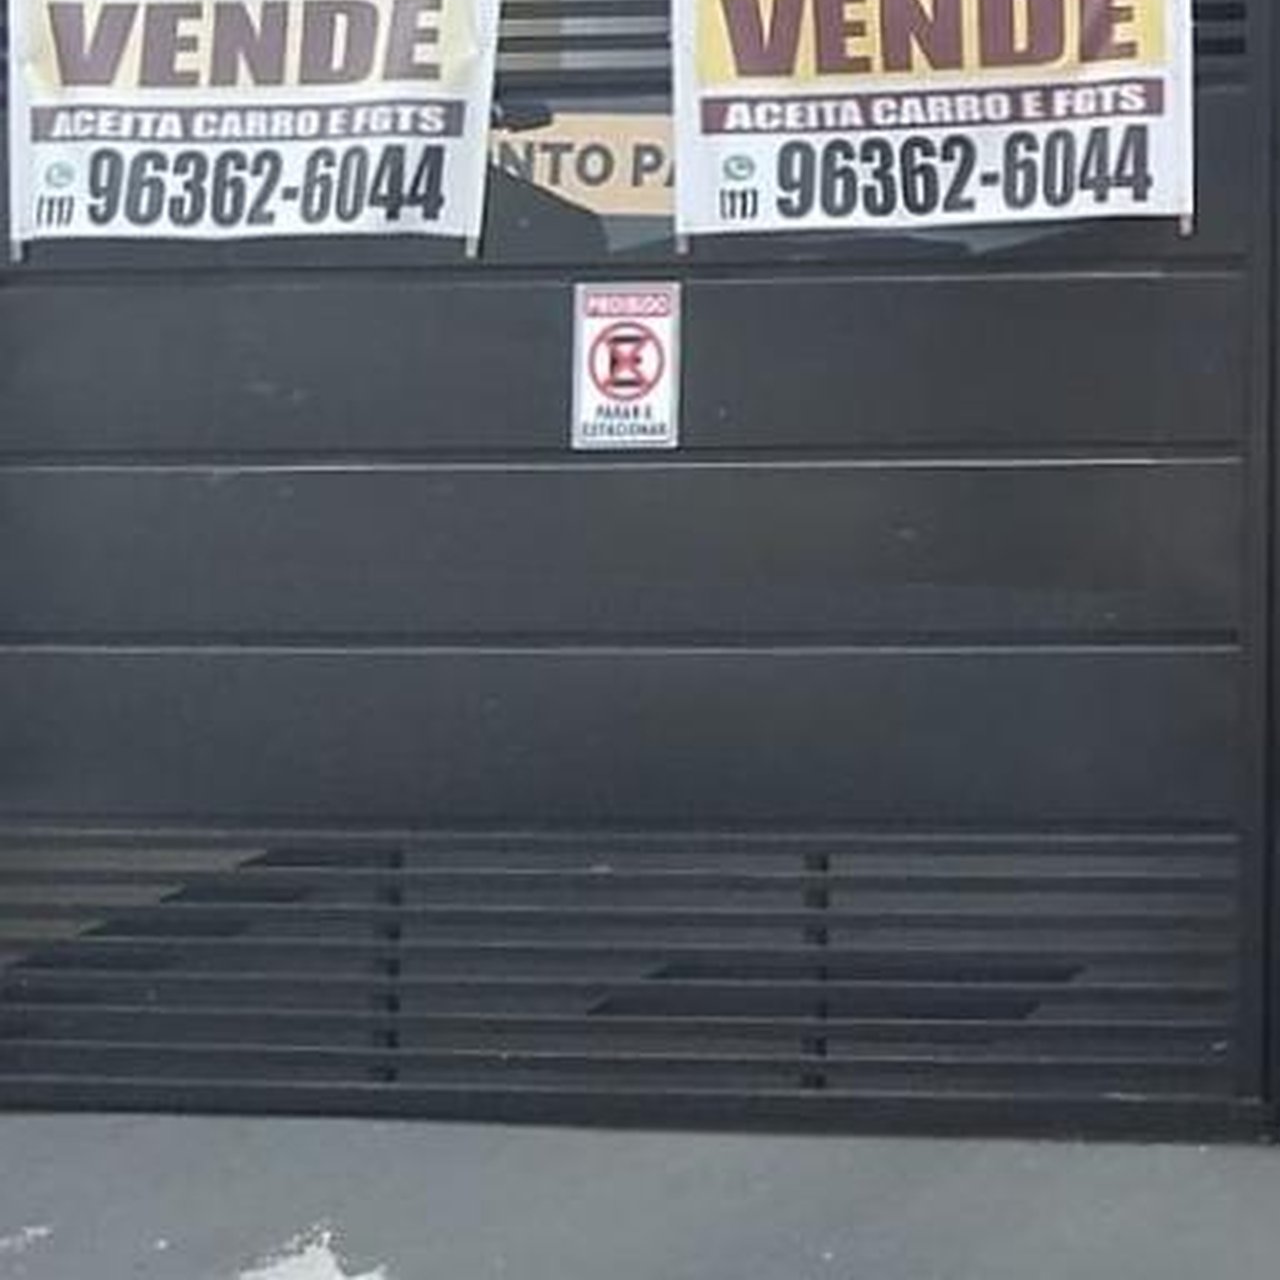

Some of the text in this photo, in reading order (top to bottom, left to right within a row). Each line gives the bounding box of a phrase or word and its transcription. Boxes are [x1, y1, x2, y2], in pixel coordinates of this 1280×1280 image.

[52, 108, 181, 138] ACEITA
[192, 108, 318, 136] CARRO
[329, 108, 349, 134] E
[725, 84, 1146, 131] ACEITA CARRO E FGTS
[87, 144, 446, 227] 96362-6044
[776, 124, 1153, 219] 96362-6044
